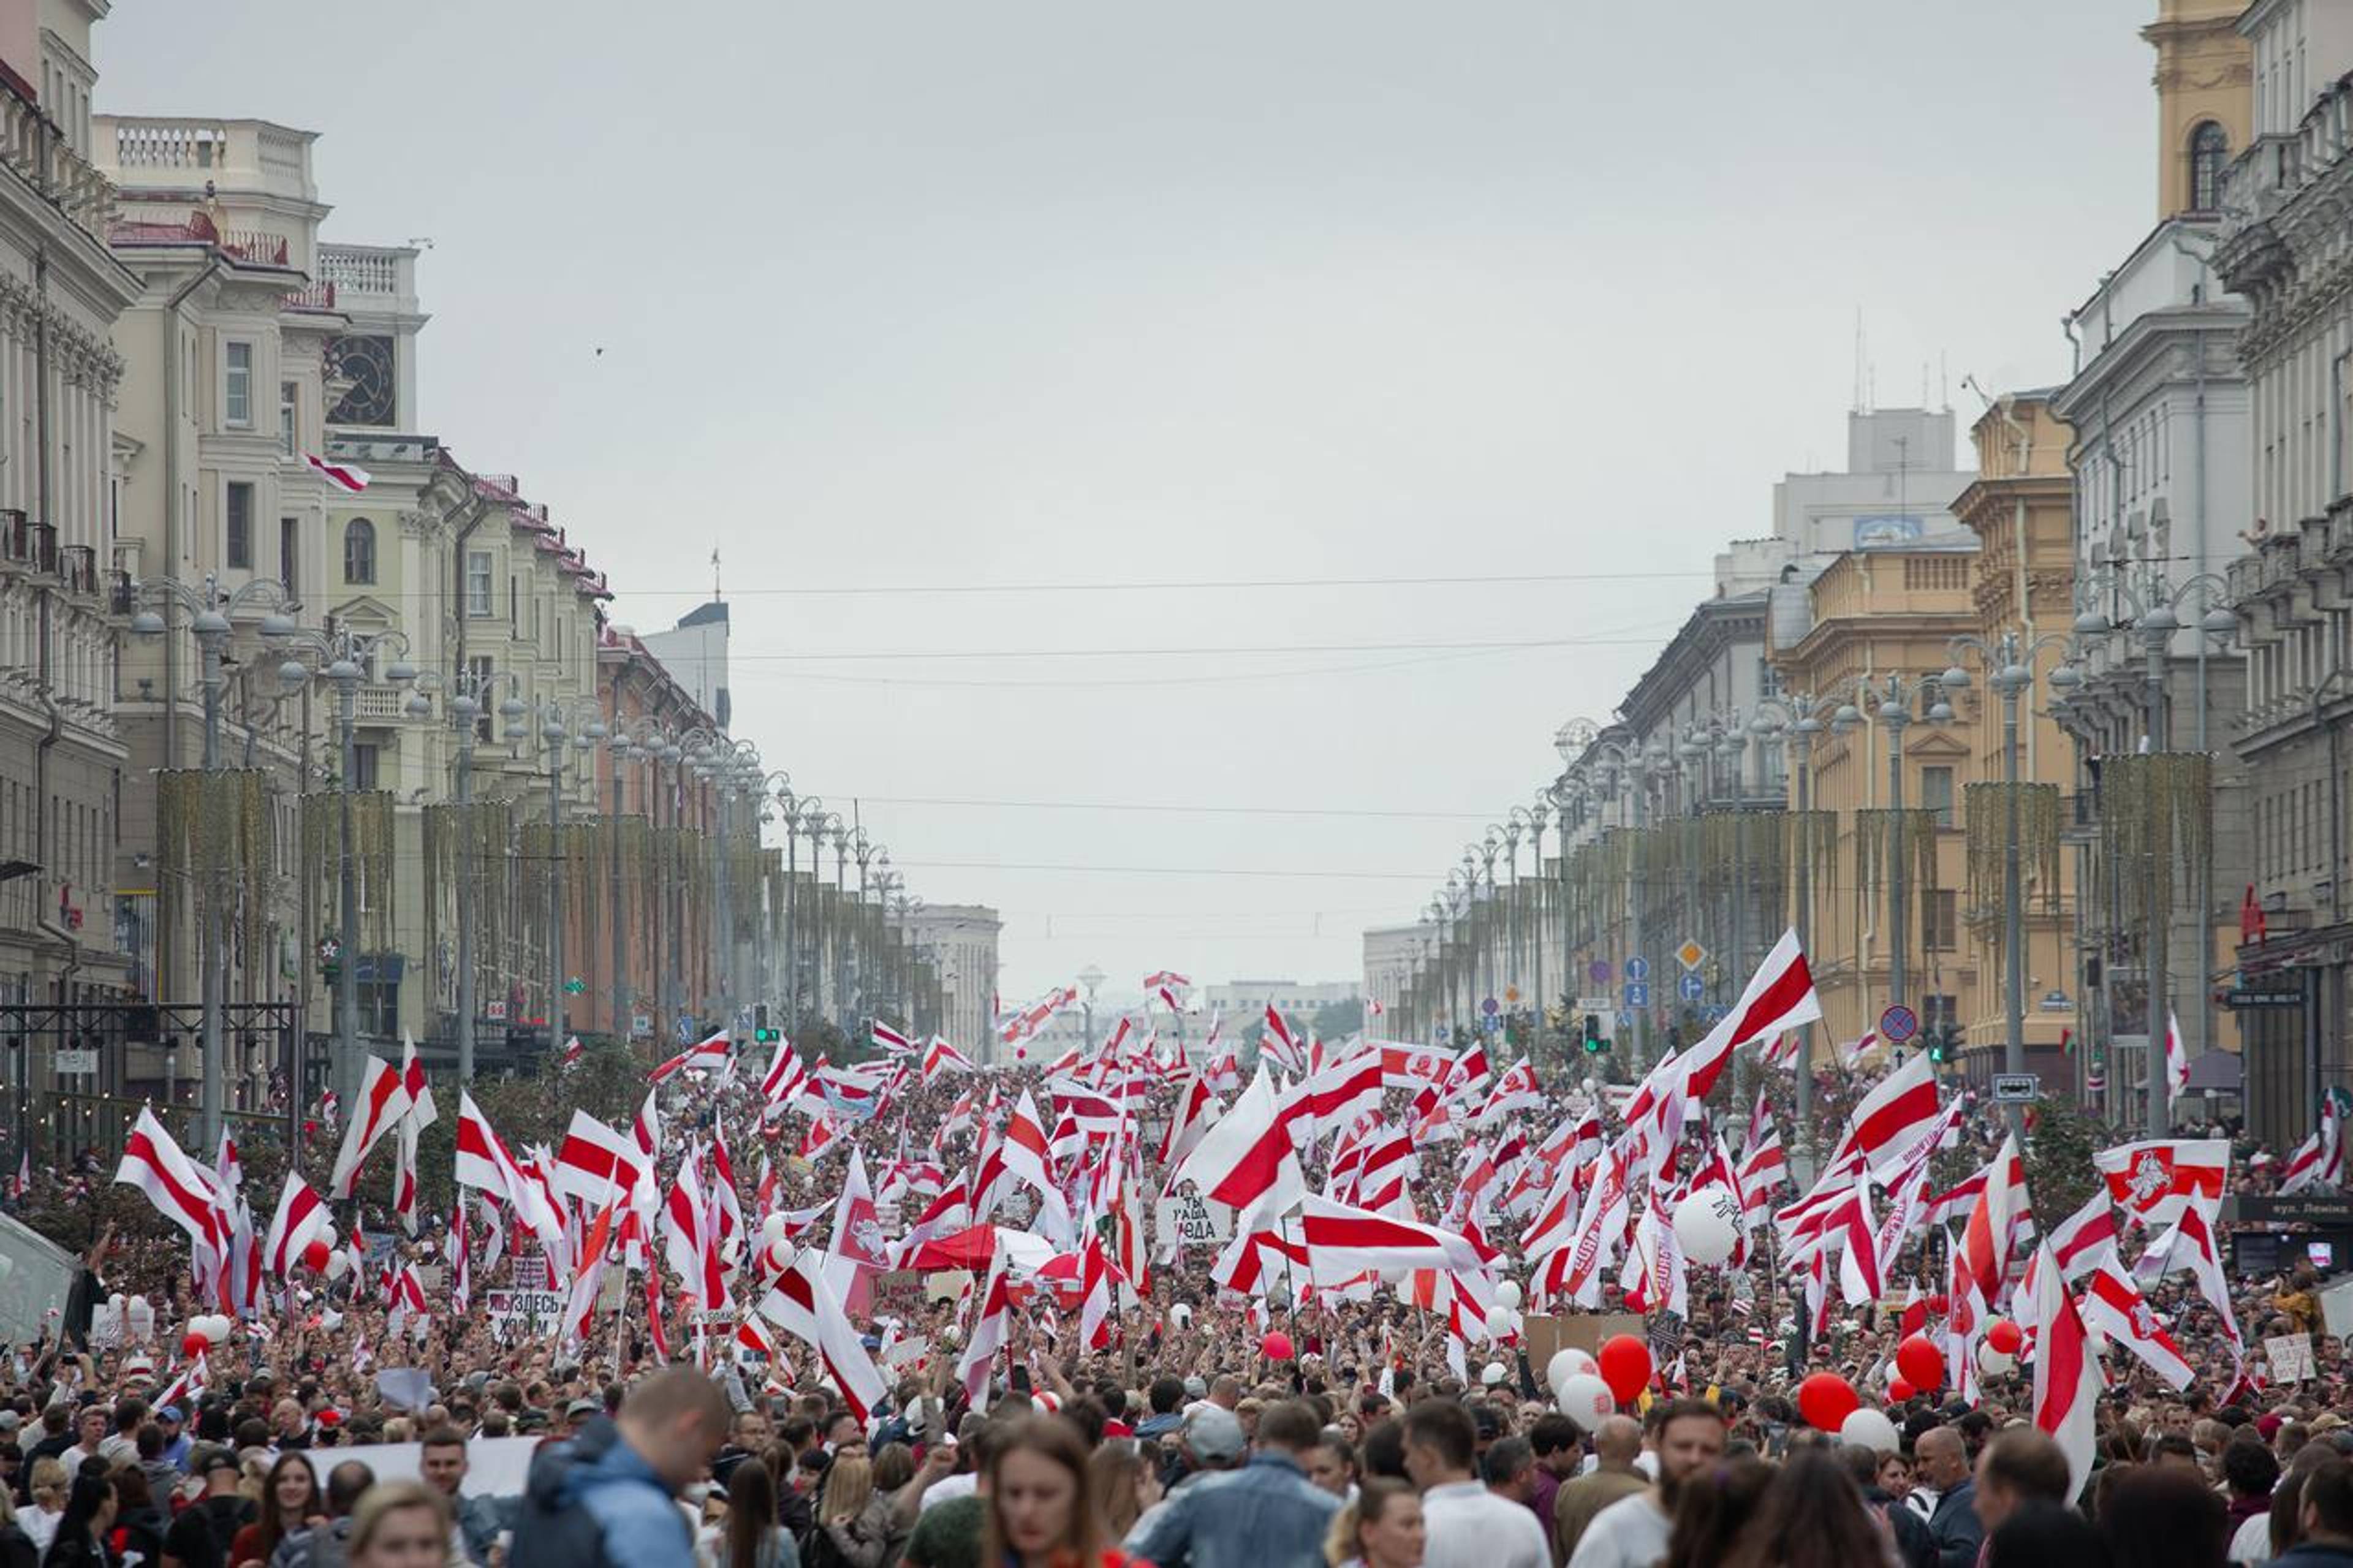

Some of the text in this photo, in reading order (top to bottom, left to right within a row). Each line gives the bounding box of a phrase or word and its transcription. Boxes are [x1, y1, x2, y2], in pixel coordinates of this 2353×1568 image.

[1183, 1196, 1203, 1208] ТЫ
[1175, 1221, 1216, 1240] ЕДА
[499, 1318, 548, 1336] ХОМ
